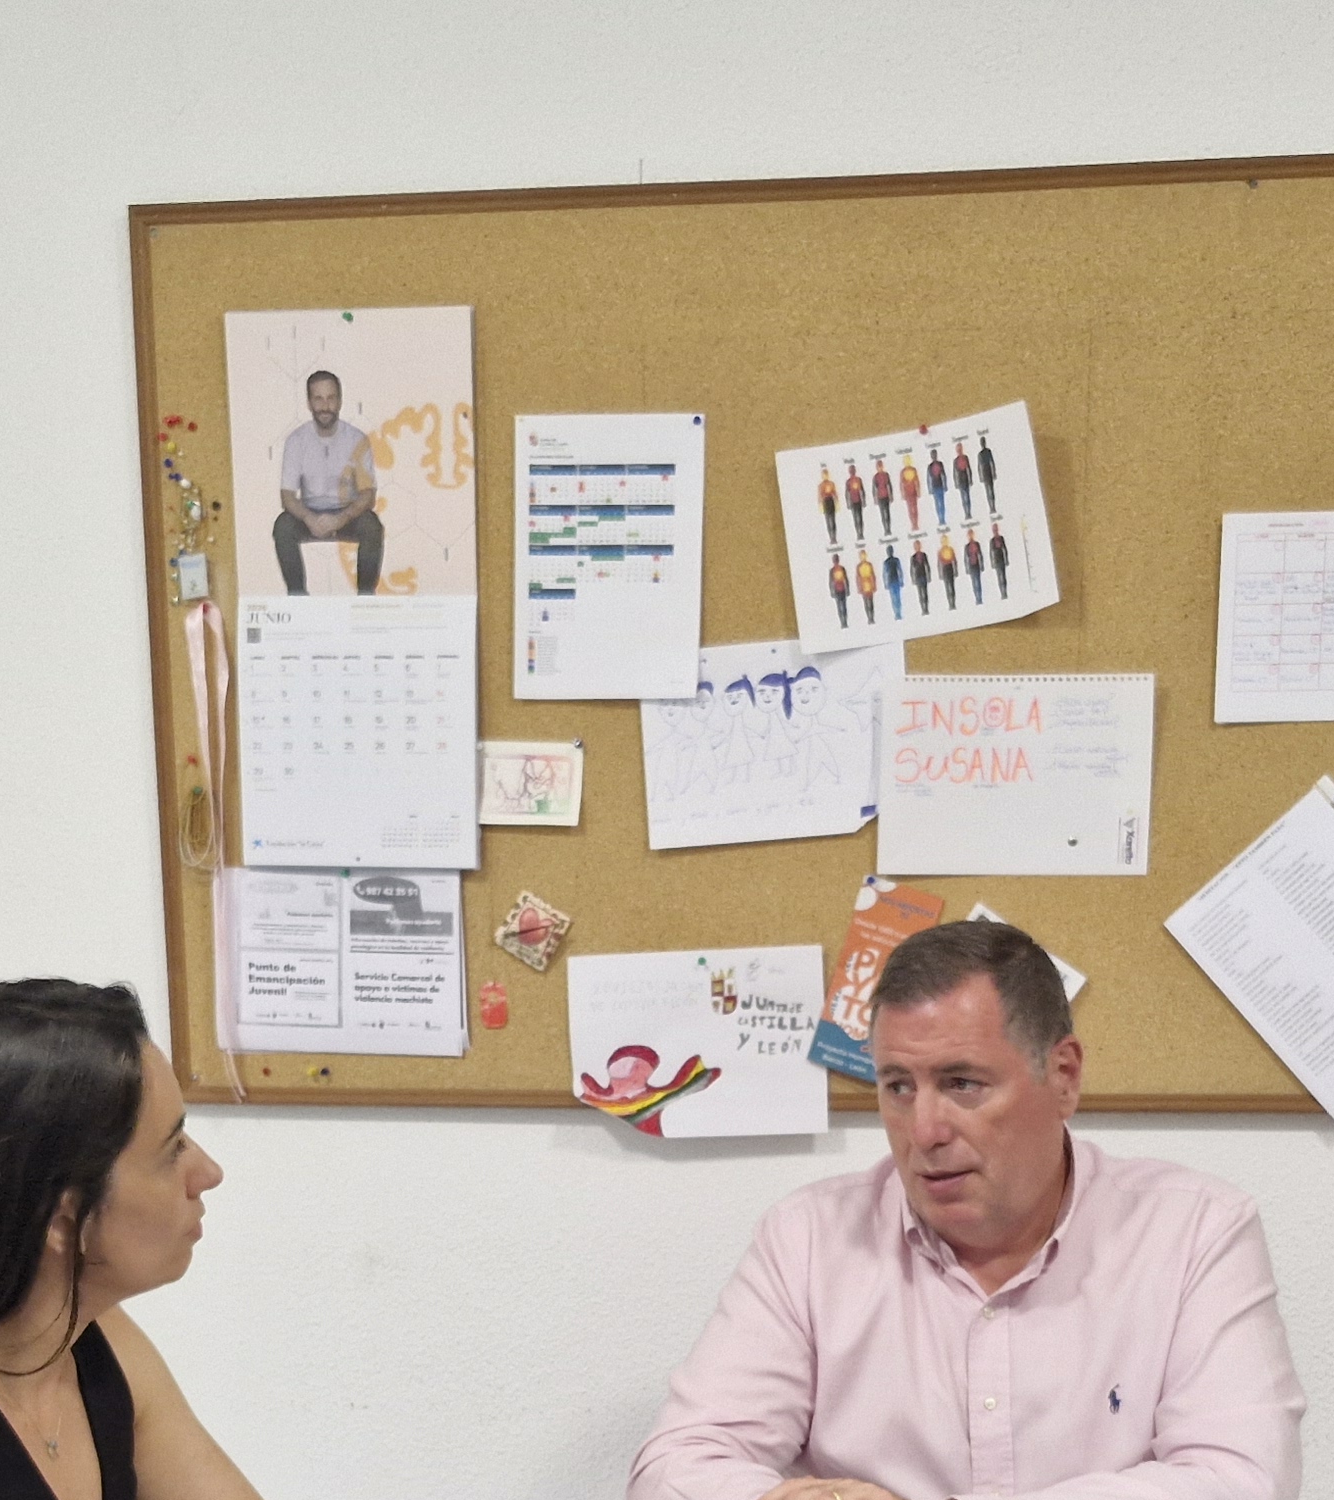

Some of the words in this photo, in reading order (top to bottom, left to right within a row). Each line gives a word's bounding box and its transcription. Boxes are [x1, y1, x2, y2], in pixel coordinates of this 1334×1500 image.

[246, 612, 292, 624] JUNIO
[248, 962, 280, 972] Punto
[283, 963, 296, 972] de
[248, 974, 326, 986] Emancipación
[354, 972, 389, 982] Servicio
[391, 973, 432, 982] Comarcal
[435, 974, 446, 983] de
[248, 986, 287, 996] Juvenil
[354, 984, 382, 994] apoyo
[354, 993, 393, 1003] violencia
